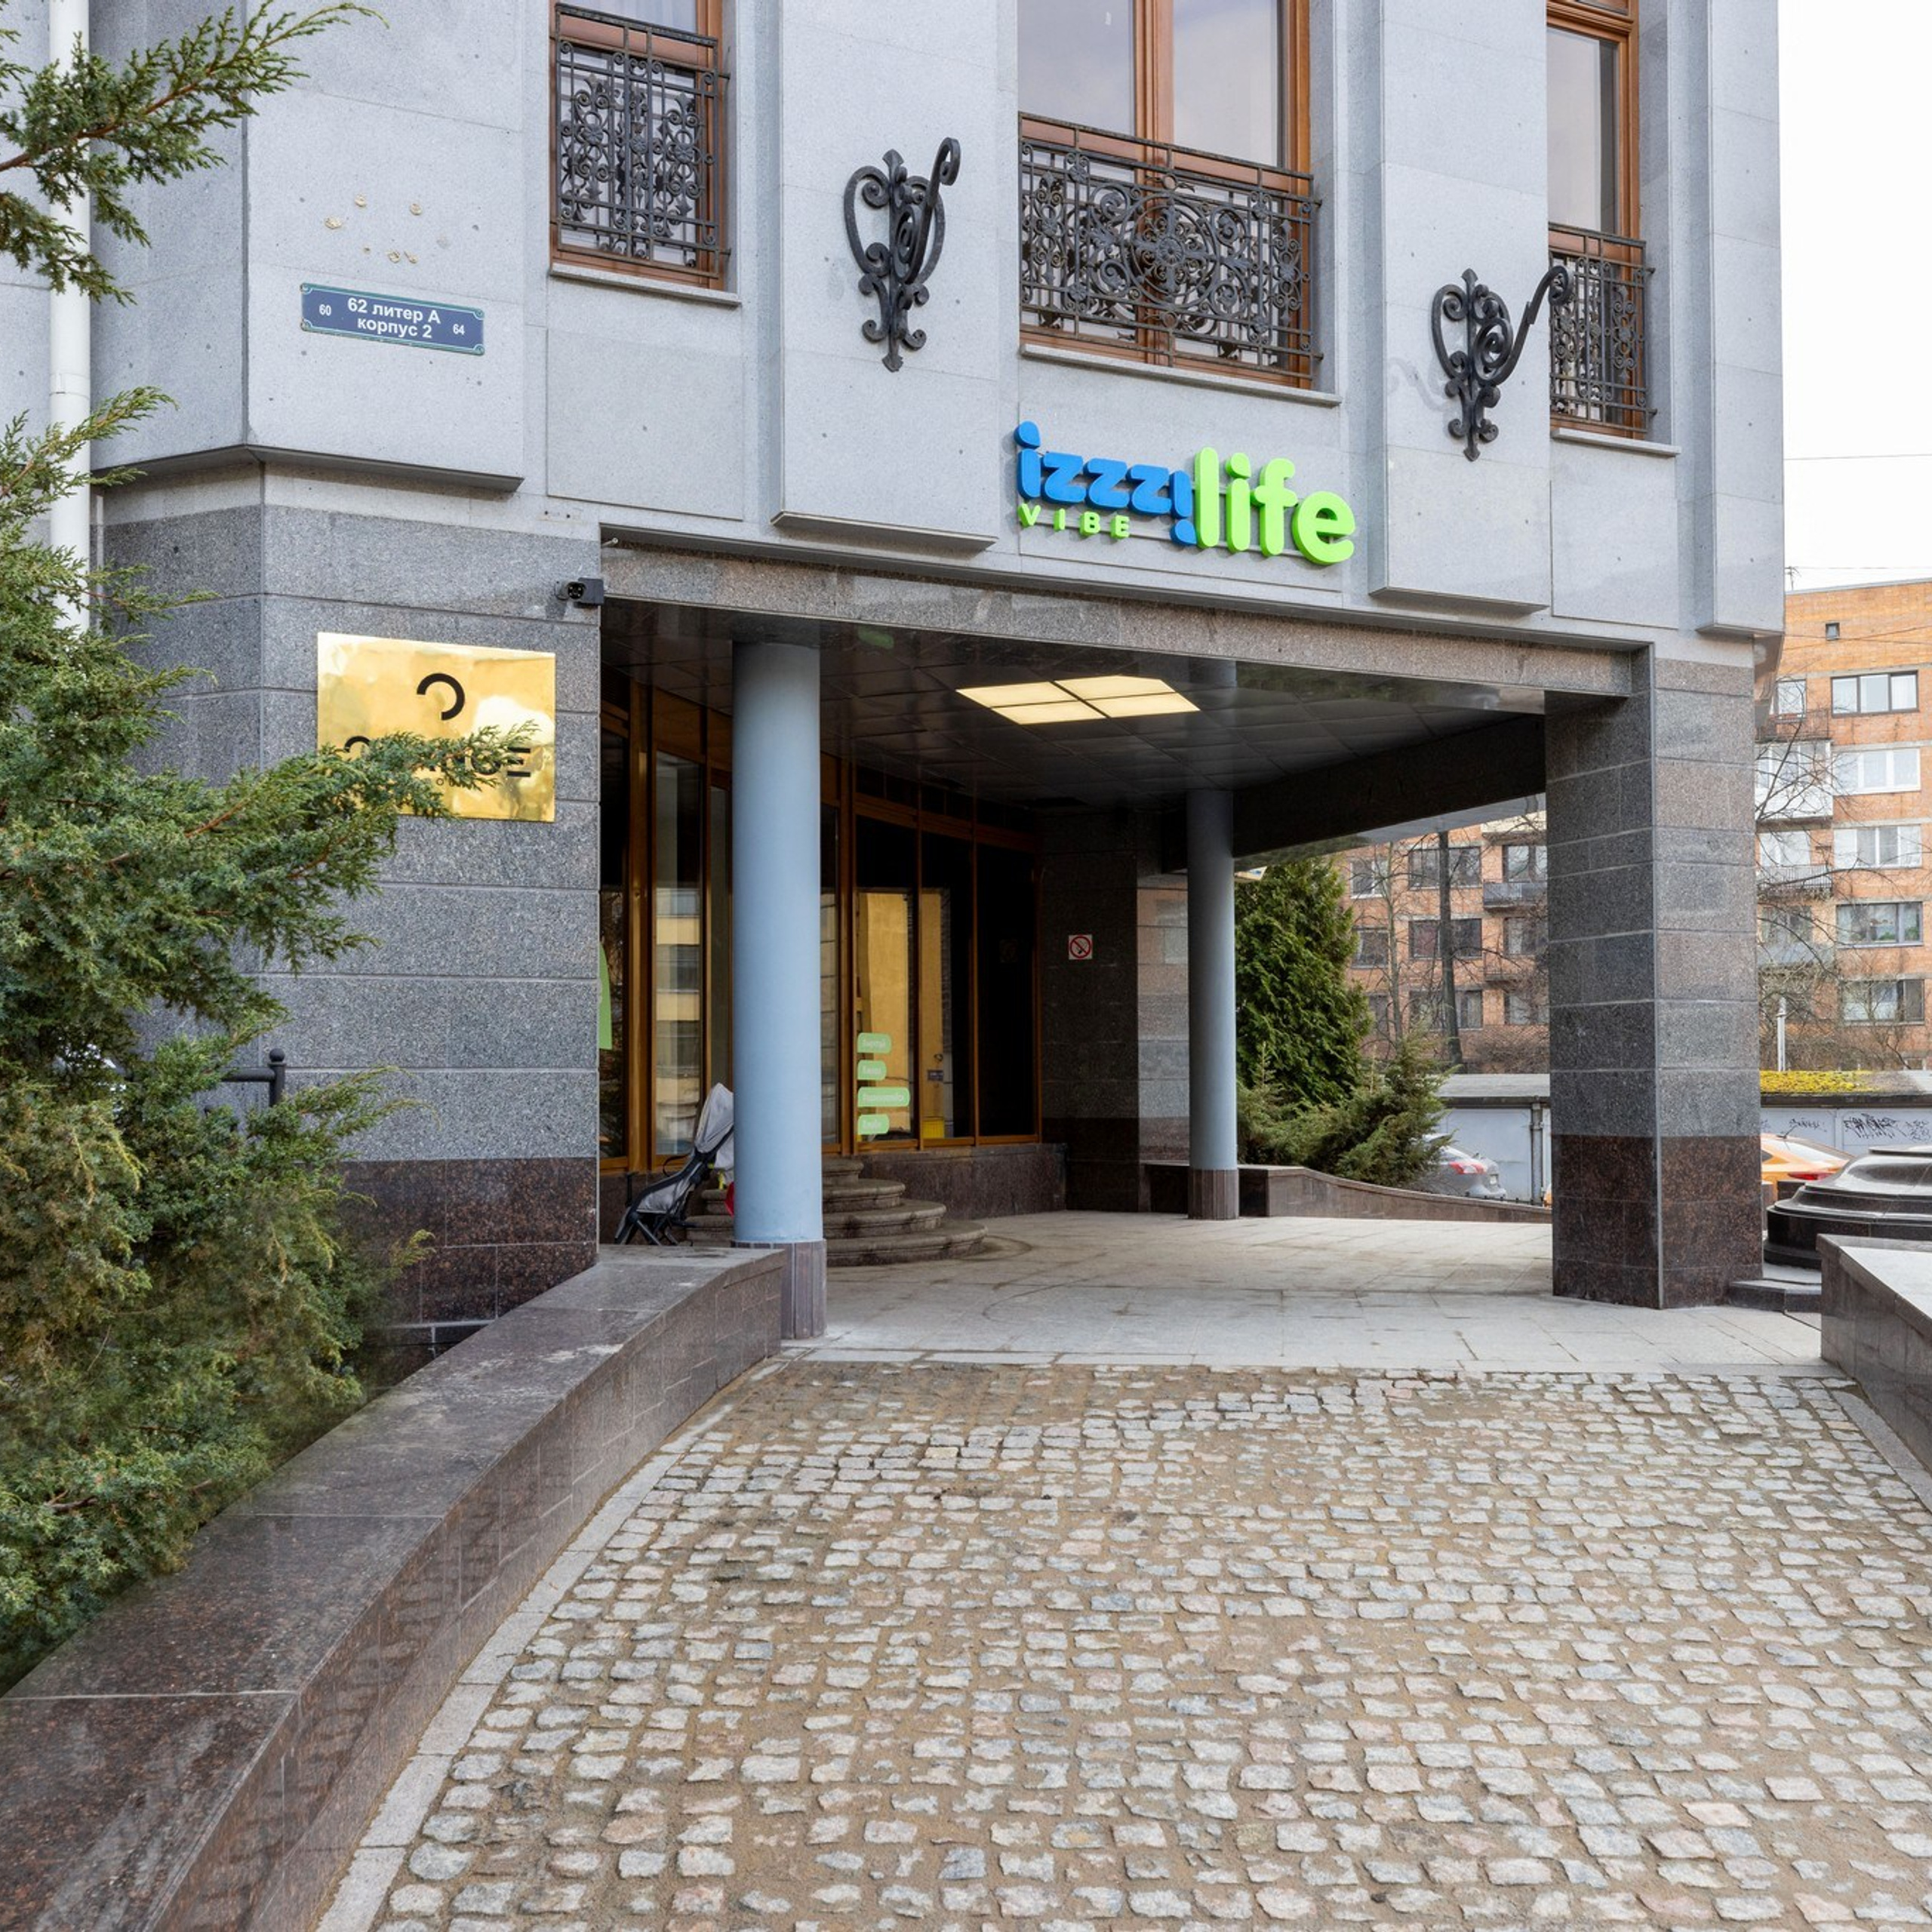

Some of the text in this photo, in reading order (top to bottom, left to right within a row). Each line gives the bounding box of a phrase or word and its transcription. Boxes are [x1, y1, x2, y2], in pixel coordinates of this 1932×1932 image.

[319, 304, 332, 316] 60
[347, 297, 441, 325] 62 литер А
[357, 317, 432, 339] корпус 2
[453, 323, 465, 336] 64
[1017, 502, 1131, 540] VIBE
